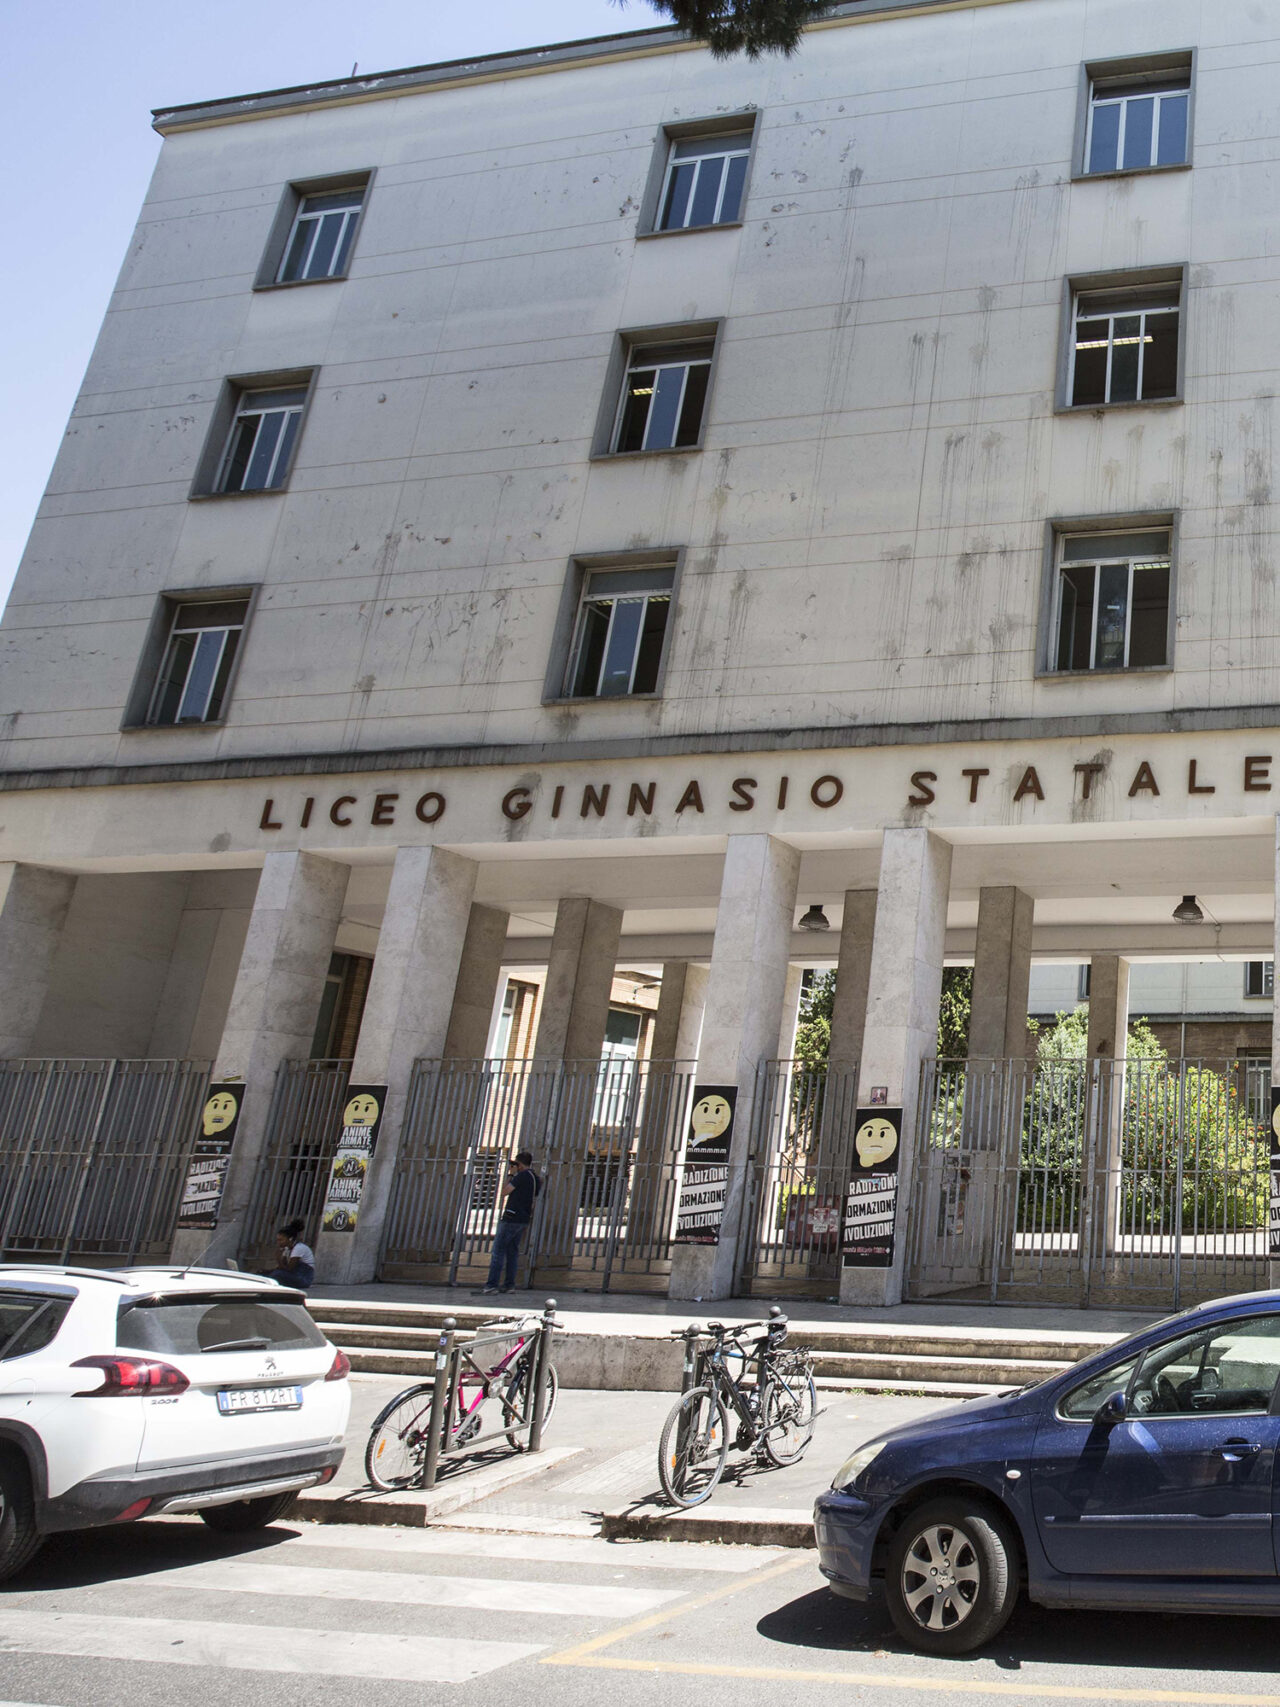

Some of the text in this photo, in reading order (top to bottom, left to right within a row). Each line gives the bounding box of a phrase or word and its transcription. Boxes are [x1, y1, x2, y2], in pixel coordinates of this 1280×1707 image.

[259, 792, 446, 830] LICEO
[502, 775, 844, 821] GINNASIO
[908, 756, 1273, 806] STATALE
[342, 1126, 372, 1137] ANIME
[340, 1136, 372, 1146] ARMATE
[332, 1179, 362, 1189] ANIME
[329, 1188, 362, 1198] ARMATE
